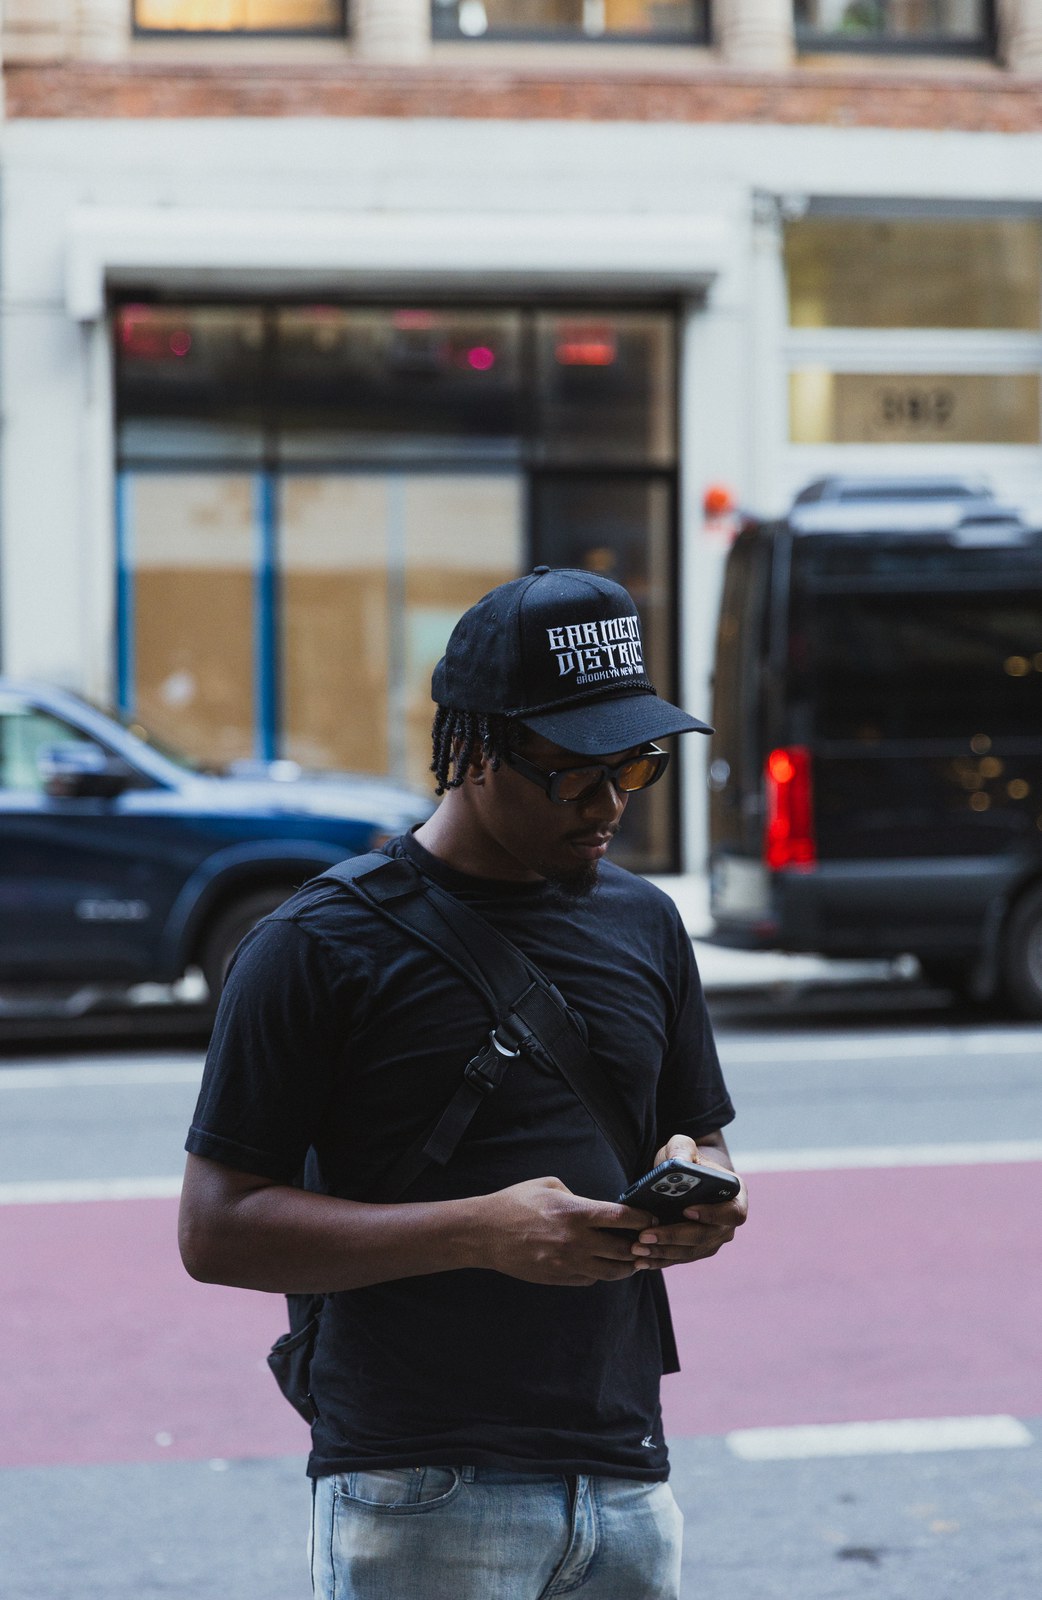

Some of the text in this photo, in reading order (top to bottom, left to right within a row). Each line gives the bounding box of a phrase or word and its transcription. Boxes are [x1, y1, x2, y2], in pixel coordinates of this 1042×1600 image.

[555, 641, 643, 677] DISTRIC
[576, 668, 620, 685] BROOKLYN
[620, 665, 634, 677] NEW
